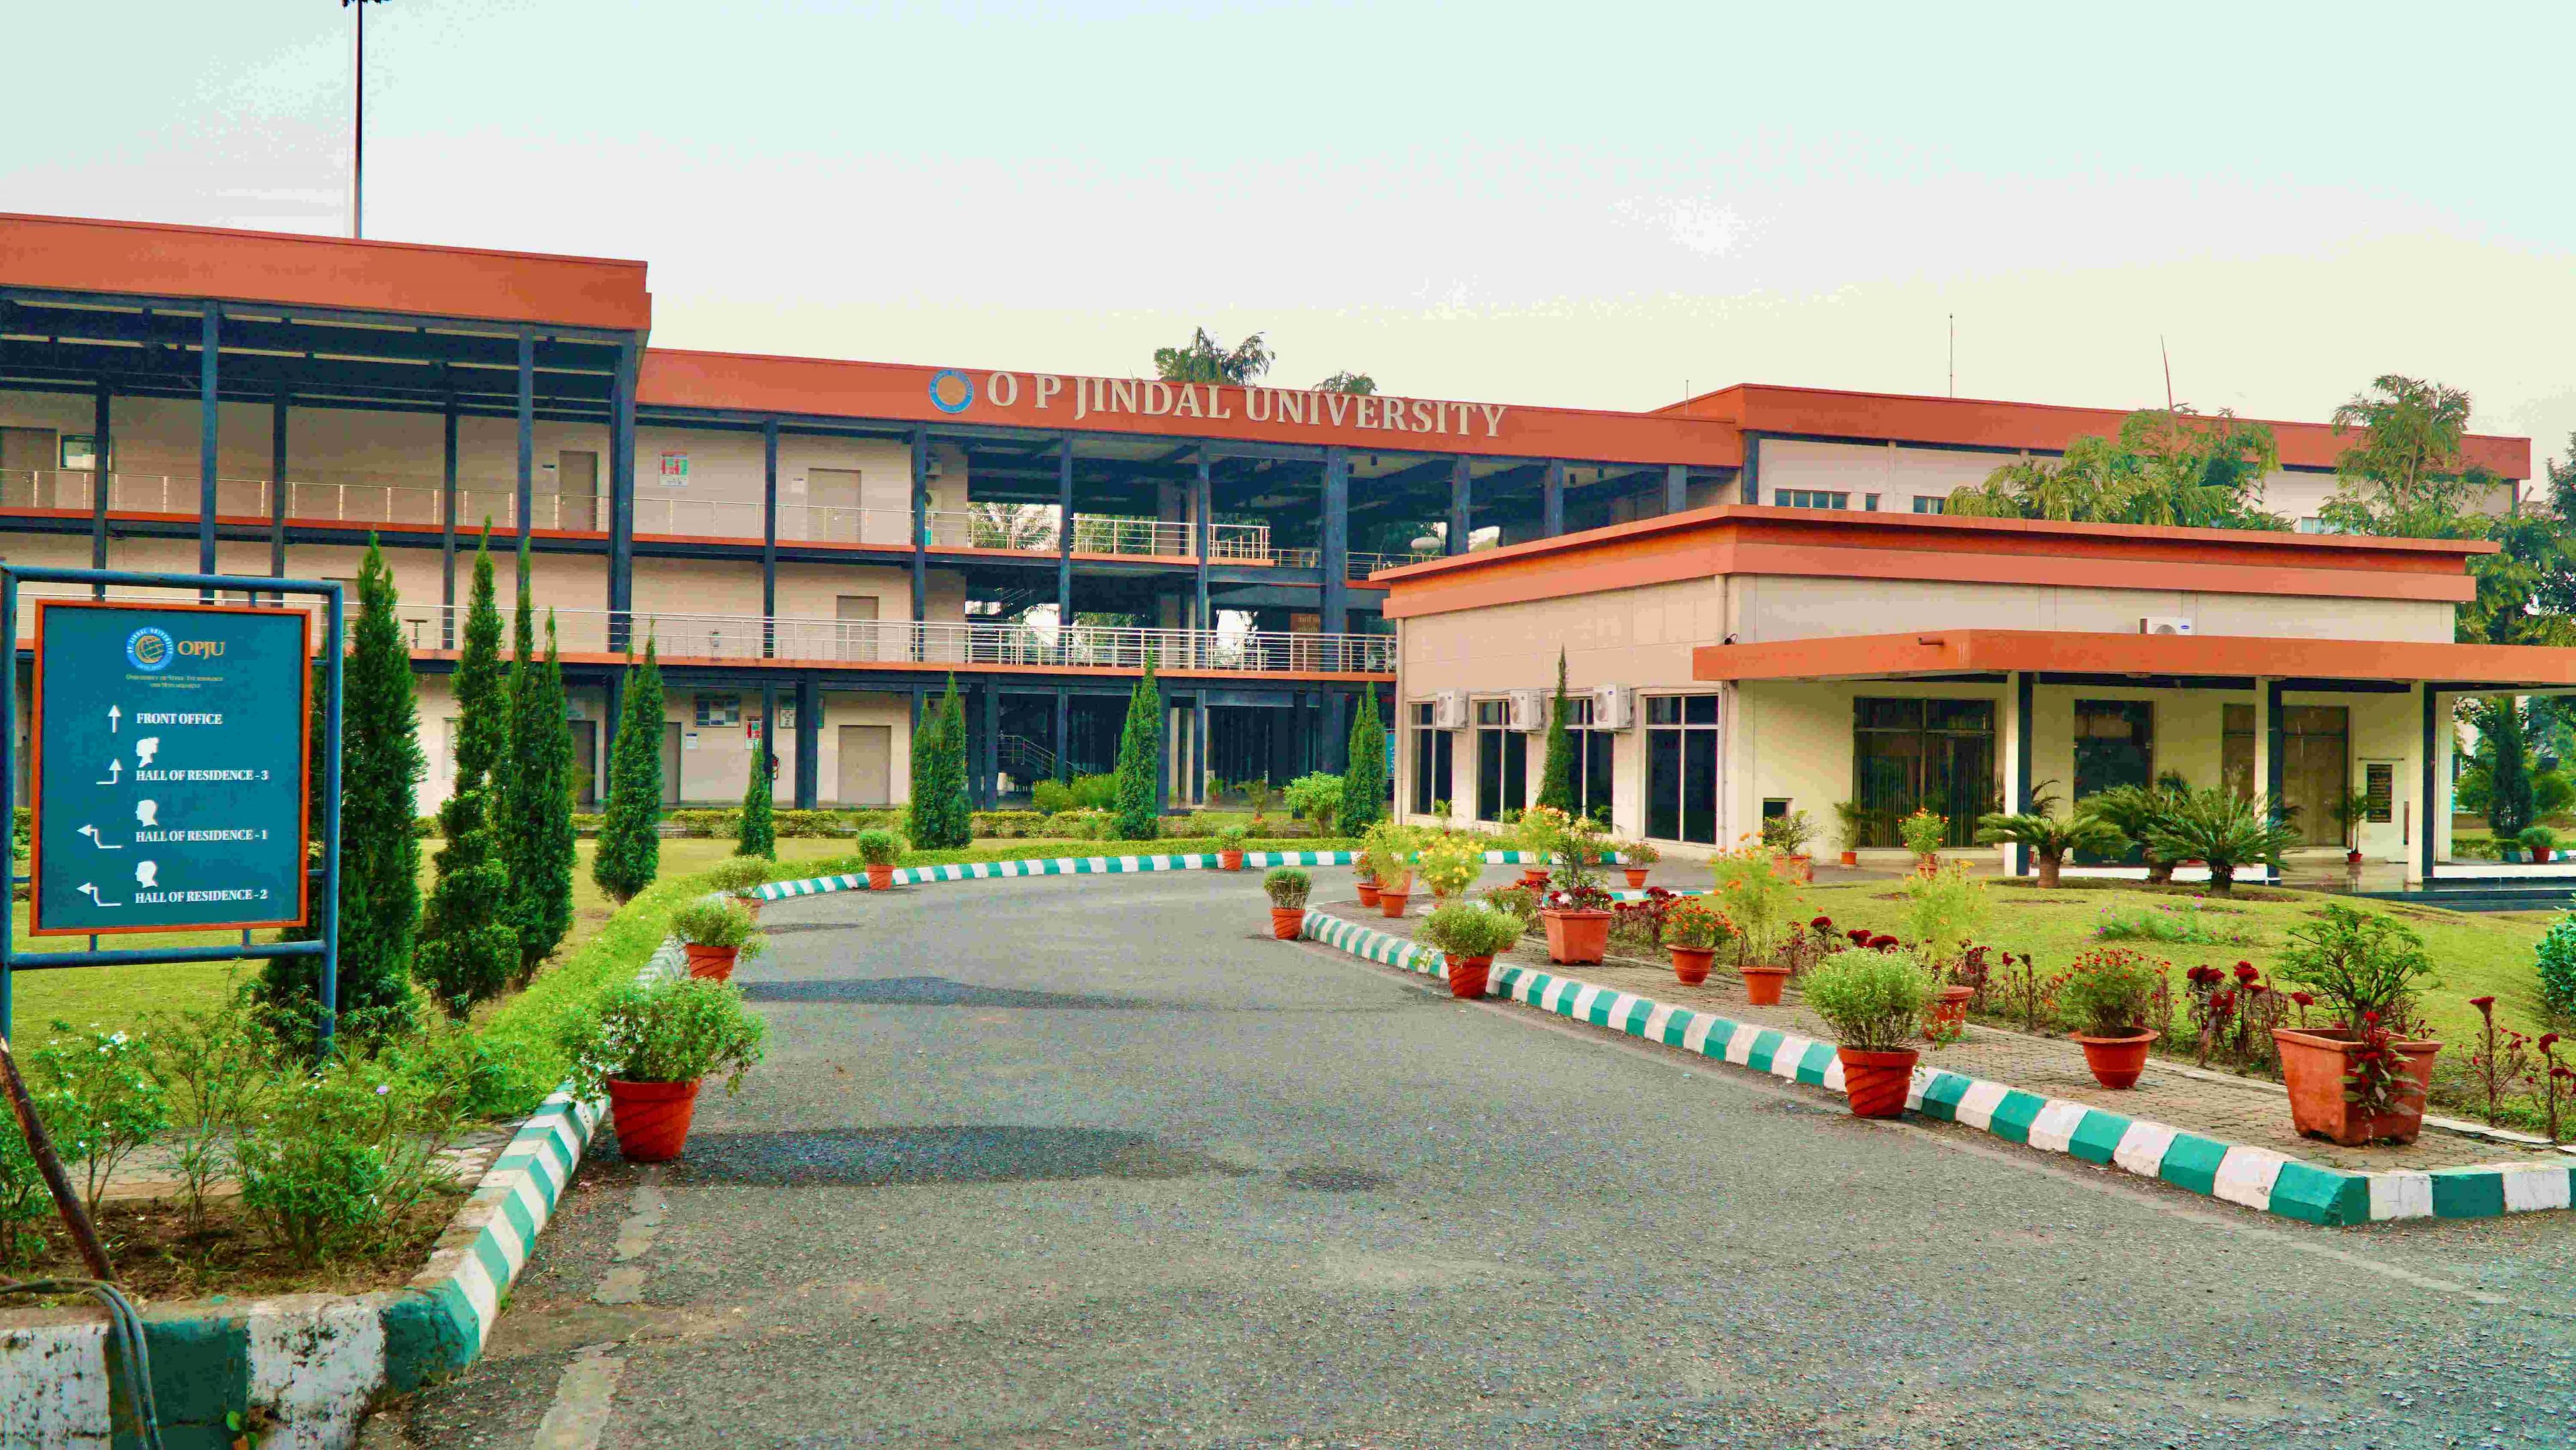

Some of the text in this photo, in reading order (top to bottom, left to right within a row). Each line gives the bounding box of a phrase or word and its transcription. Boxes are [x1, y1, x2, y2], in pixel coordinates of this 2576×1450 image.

[987, 371, 1018, 407] O
[1033, 374, 1062, 409] P
[1074, 376, 1231, 420] JINDAL
[1244, 386, 1508, 437] UNIVERSITY
[177, 640, 226, 660] OPJU
[137, 713, 223, 725] FRONT OFFICE
[136, 770, 167, 781] HALL
[169, 770, 185, 781] OF
[187, 770, 254, 781] RESIDENCE
[261, 770, 269, 780] 3
[136, 831, 167, 842] HALL
[169, 830, 185, 841] OF
[187, 829, 254, 841] RESIDENCE
[262, 829, 268, 840] 1
[136, 892, 167, 904] HALL
[168, 891, 184, 902] OF
[186, 889, 254, 902] RESIDENCE
[260, 889, 268, 899] 2
